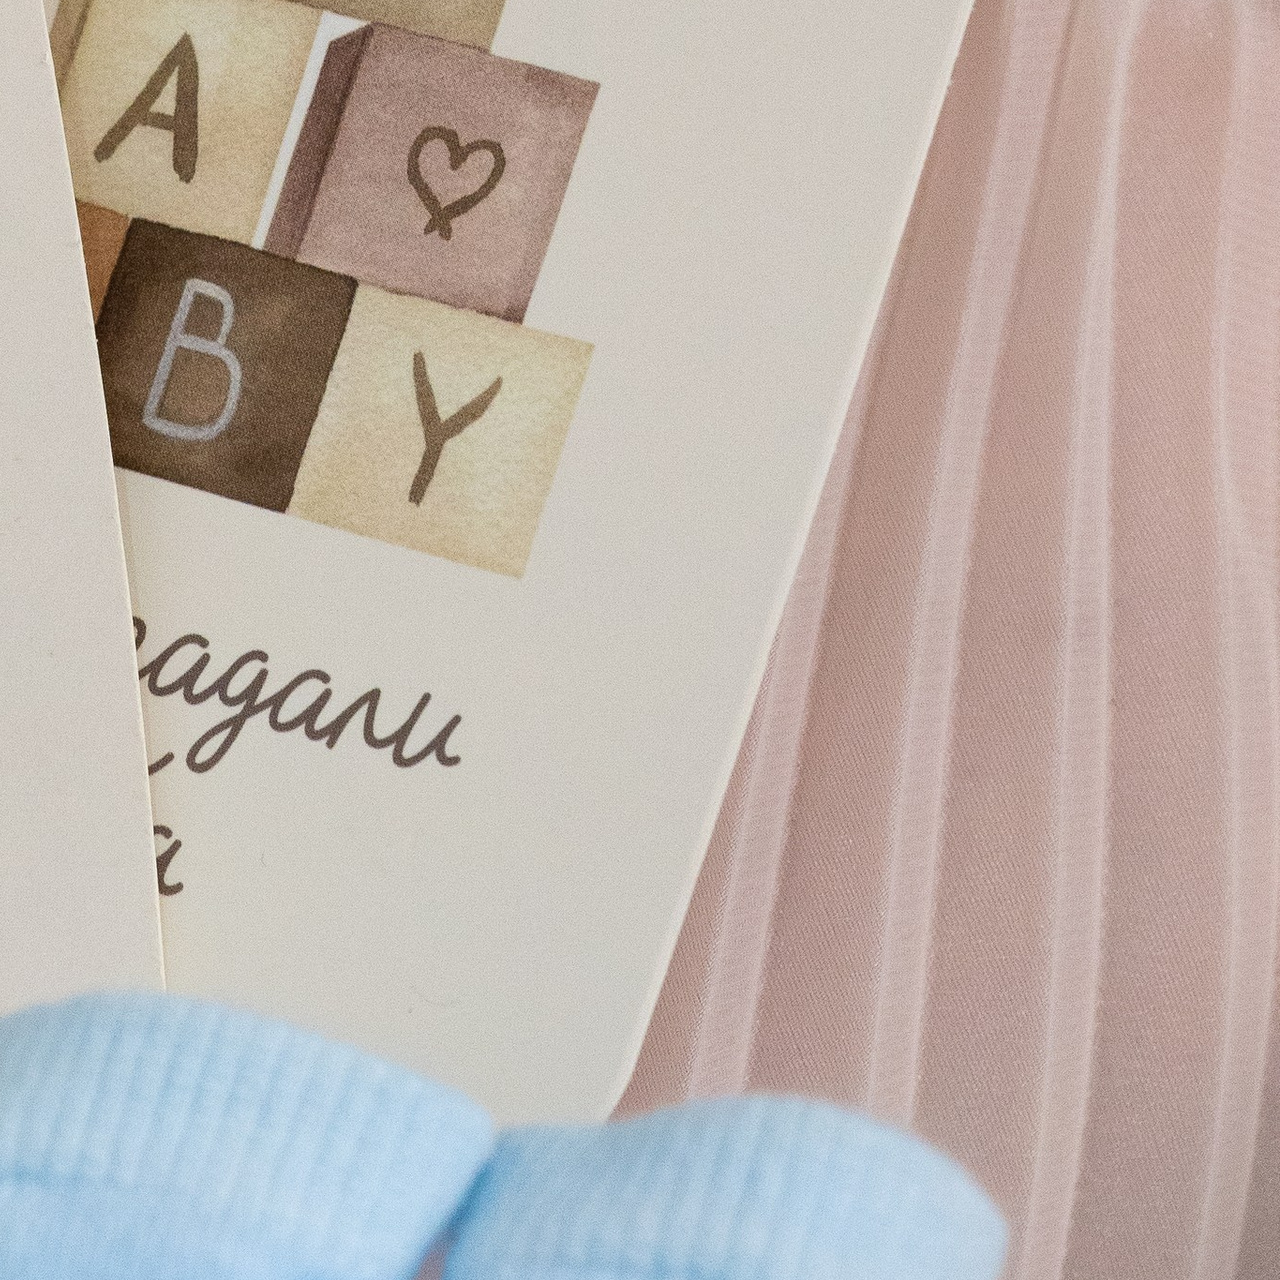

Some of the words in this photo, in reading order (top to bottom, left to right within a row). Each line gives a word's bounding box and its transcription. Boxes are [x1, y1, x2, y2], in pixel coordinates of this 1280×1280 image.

[93, 32, 200, 184] A
[142, 277, 243, 442] B
[408, 350, 504, 507] Y
